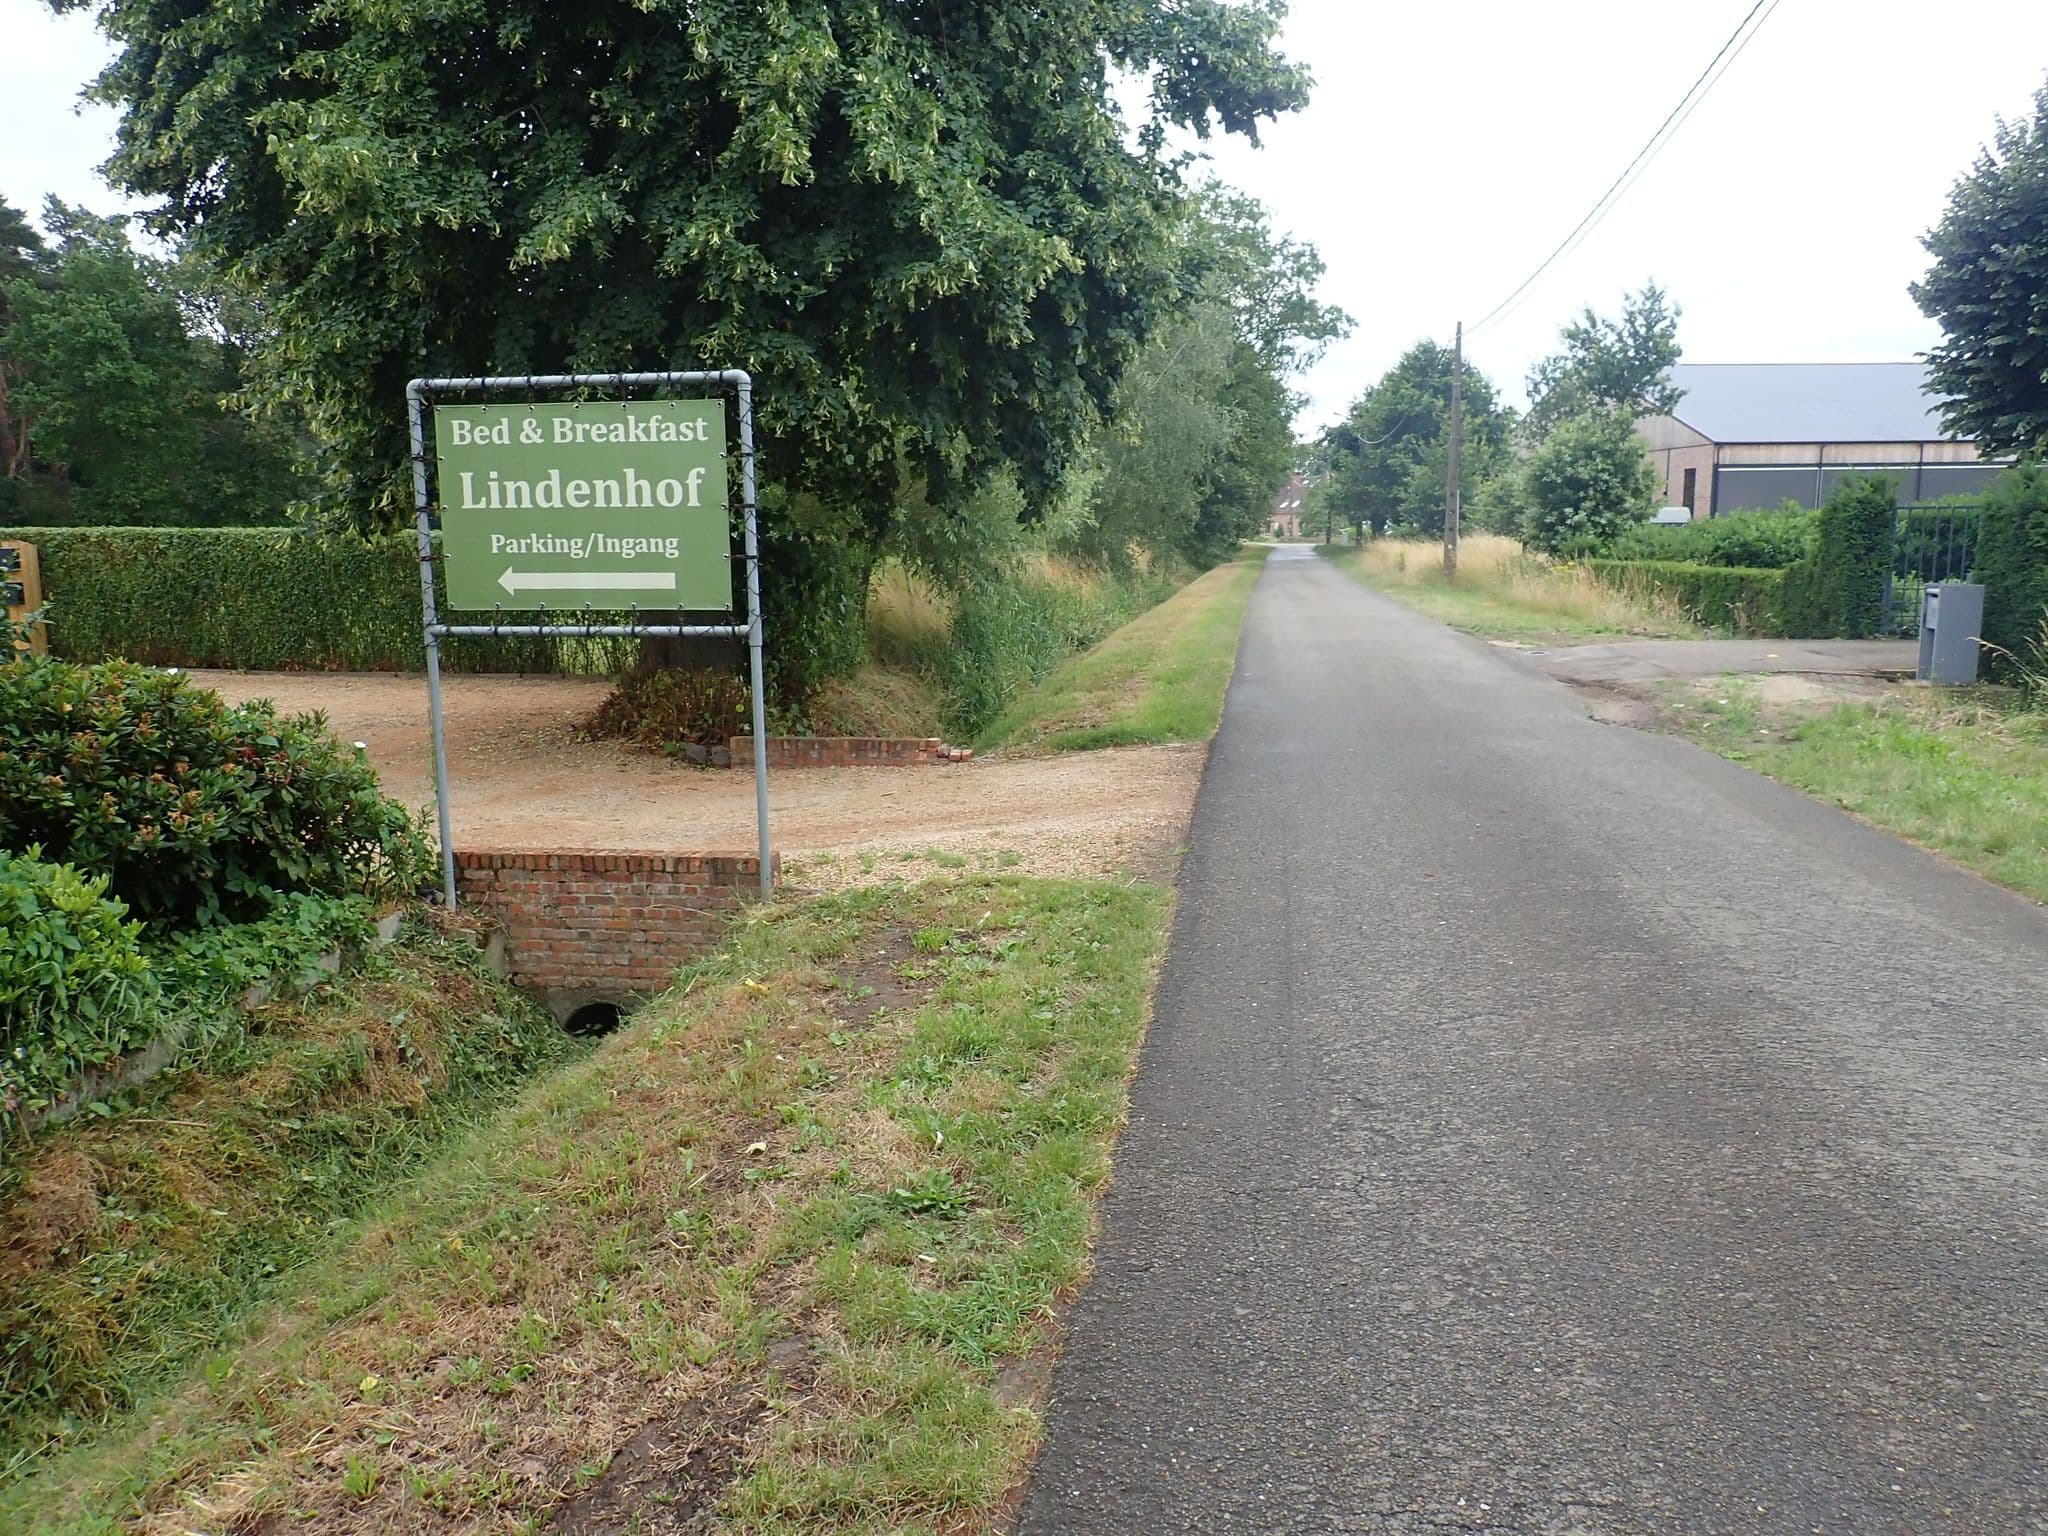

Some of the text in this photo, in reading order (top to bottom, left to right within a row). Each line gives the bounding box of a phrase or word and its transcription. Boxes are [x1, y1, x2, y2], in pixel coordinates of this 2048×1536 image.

[451, 415, 708, 446] Bed & Breakfast
[460, 467, 705, 510] Lindenhof
[490, 533, 679, 559] Parking/Ingang
